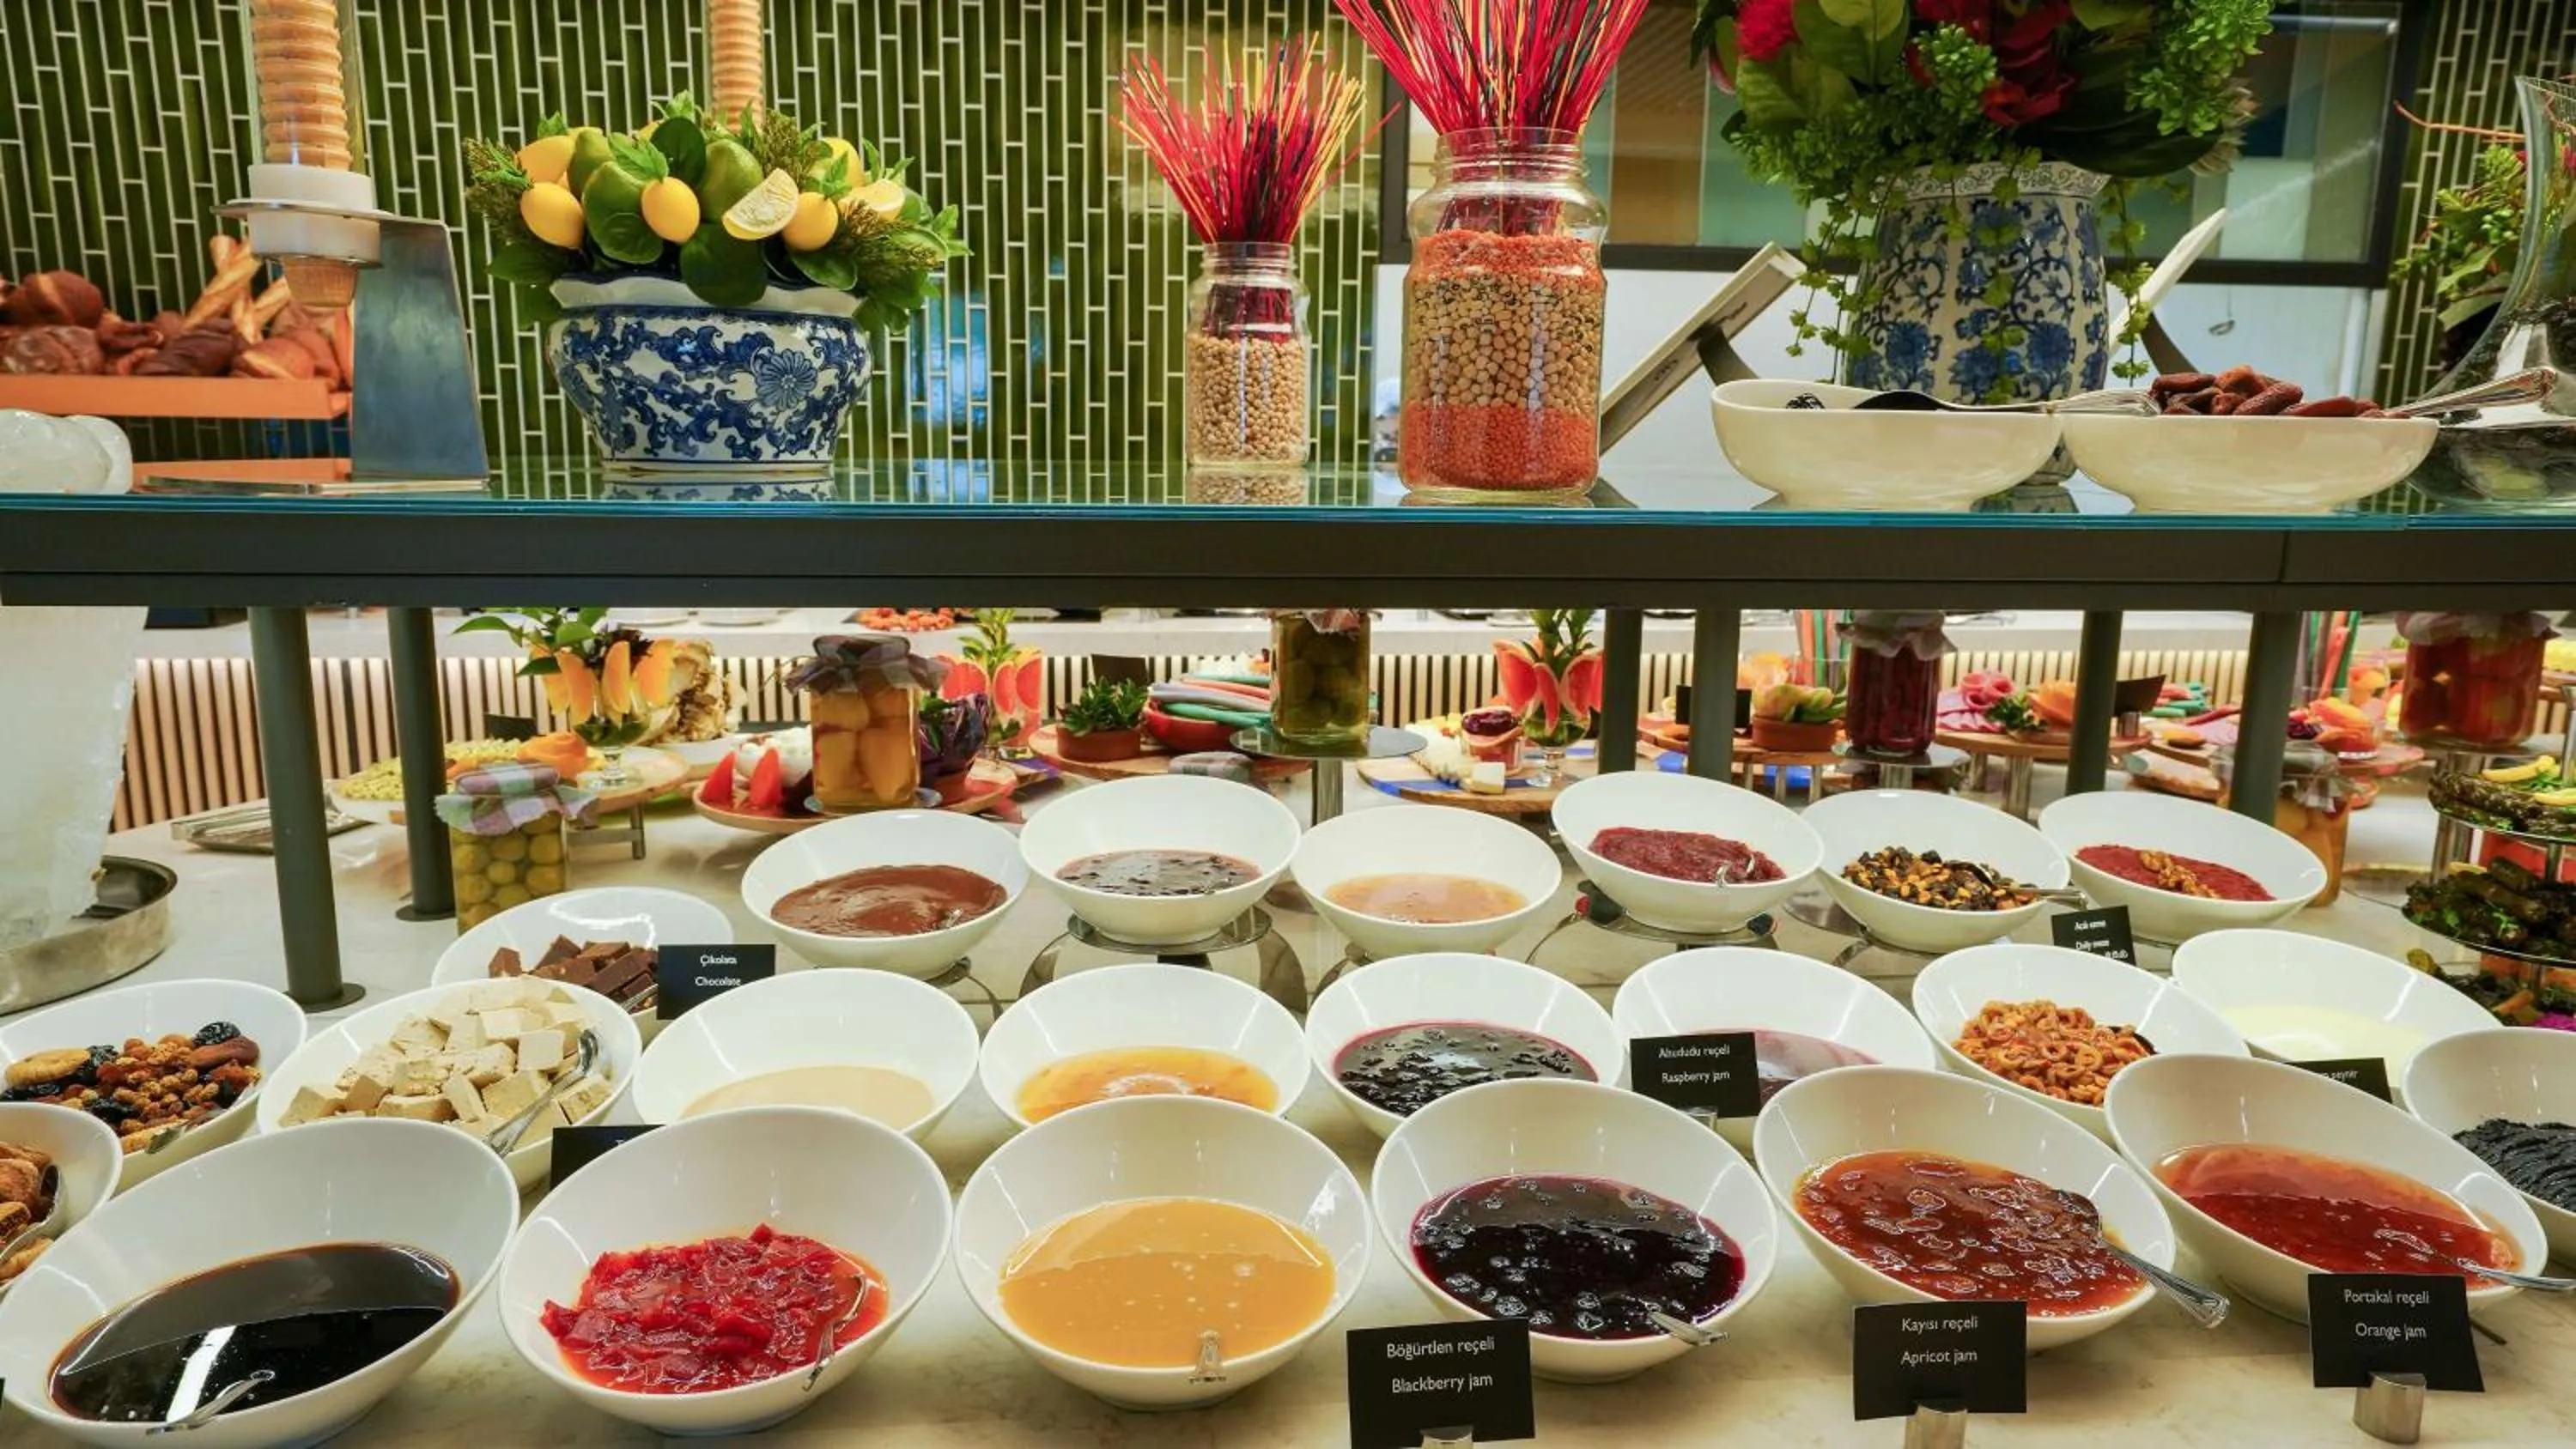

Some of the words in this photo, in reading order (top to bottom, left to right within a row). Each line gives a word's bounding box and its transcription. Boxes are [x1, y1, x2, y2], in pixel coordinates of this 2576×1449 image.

[700, 955, 738, 967] Çikolata
[695, 976, 741, 986] Chocolate
[1658, 1046, 1700, 1058] Ahududu
[1703, 1044, 1730, 1058] reçeli
[1662, 1071, 1710, 1085] Raspberry
[1713, 1070, 1730, 1082] jam
[2343, 1288, 2393, 1304] Portakal
[2397, 1291, 2429, 1307] reçeli
[1901, 1318, 1938, 1335] Kayısı
[1942, 1315, 1978, 1333] reçeli
[2355, 1322, 2401, 1340] Orange
[2404, 1325, 2427, 1341] jam
[1387, 1339, 1453, 1360] Böğürtlen
[1457, 1336, 1495, 1355] reçeli
[1900, 1350, 1950, 1367] Apricot
[1953, 1349, 1978, 1366] jam
[1392, 1376, 1464, 1393] Blackberry
[1468, 1373, 1492, 1391] jam
